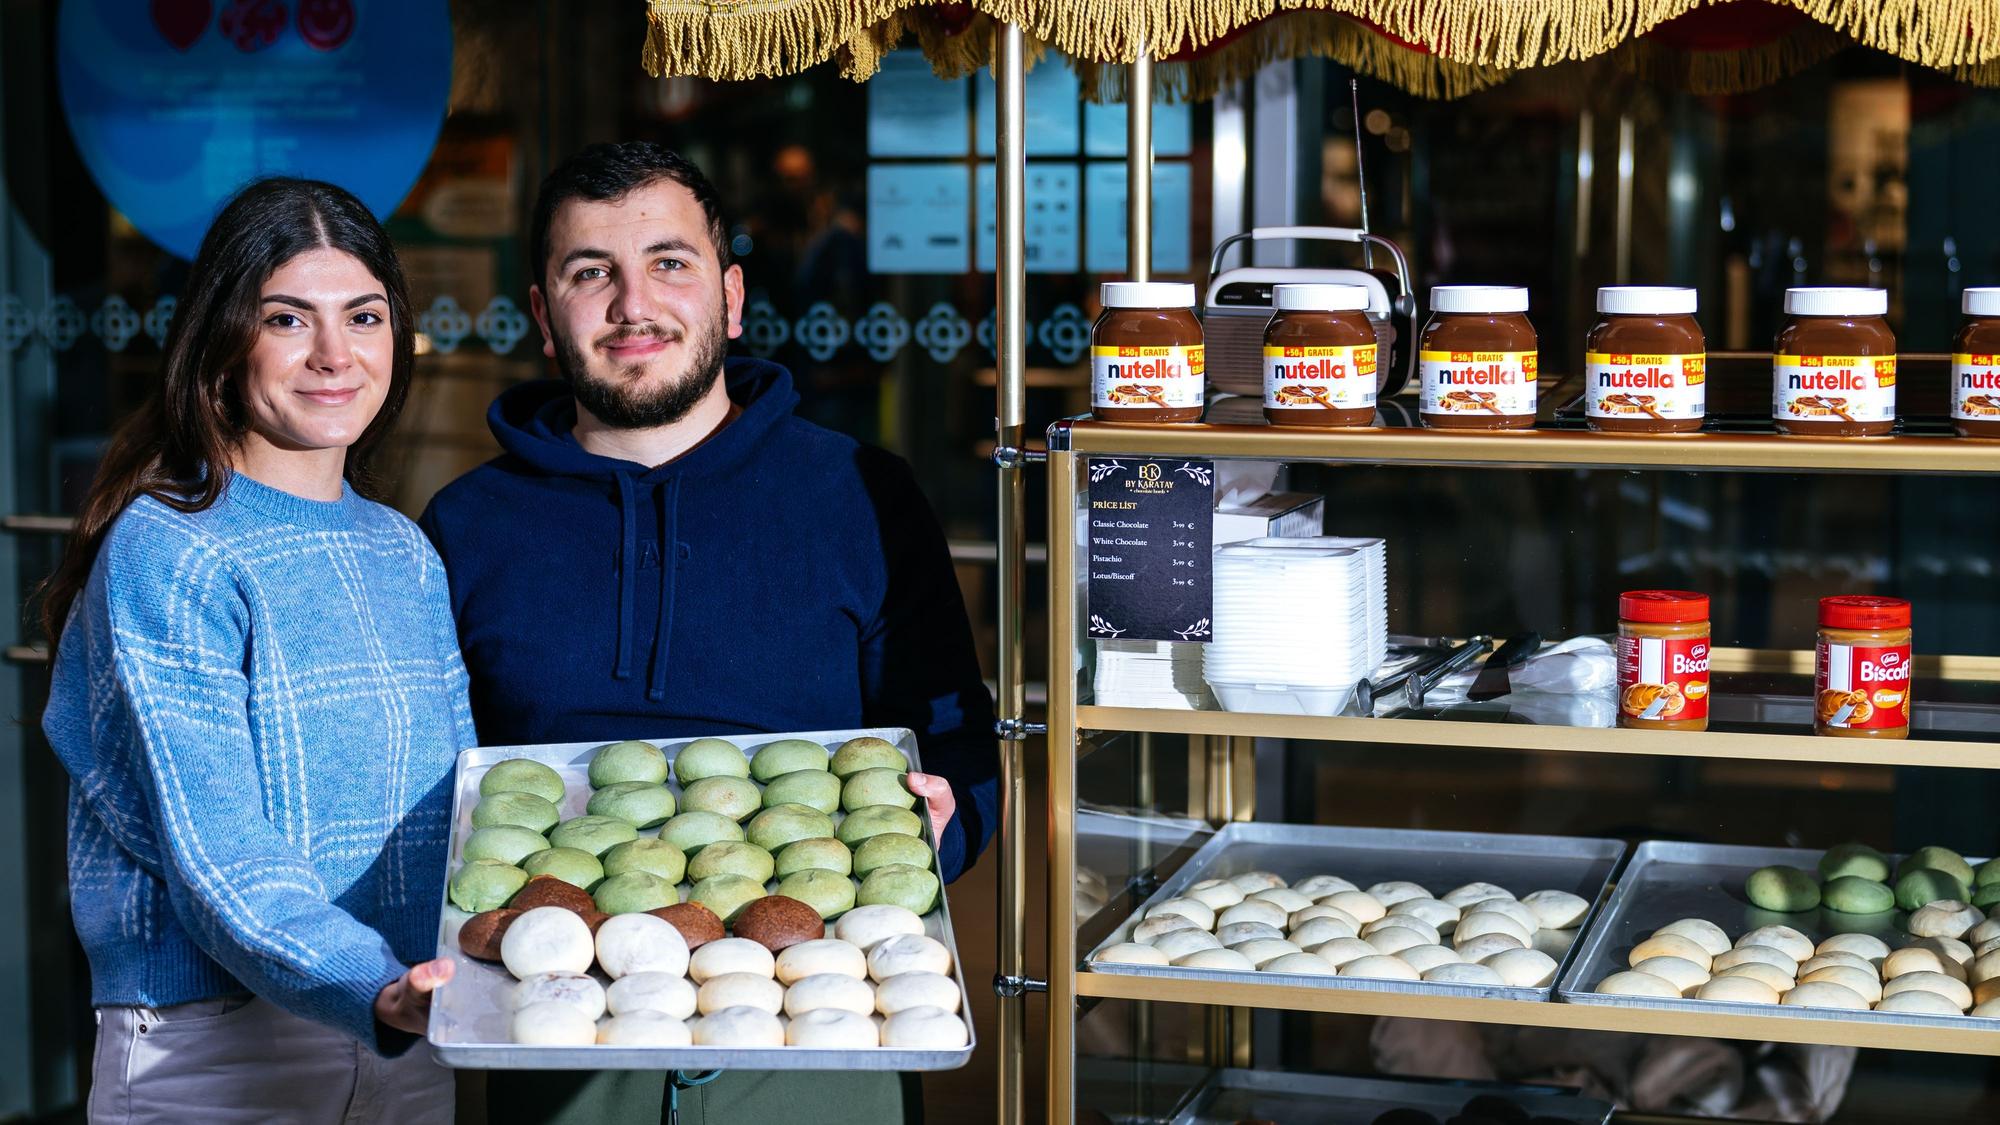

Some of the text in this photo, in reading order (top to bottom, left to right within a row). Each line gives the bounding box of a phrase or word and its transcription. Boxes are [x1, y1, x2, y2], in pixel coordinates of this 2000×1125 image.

[1477, 354, 1503, 362] GRATIS
[1108, 359, 1181, 378] nutella
[1275, 360, 1345, 379] nutella
[1440, 365, 1515, 384] nutella
[1600, 368, 1674, 388] nutella
[1789, 370, 1866, 390] nutella
[1962, 370, 2000, 388] nute
[1138, 480, 1174, 489] KARATAY
[1093, 520, 1115, 528] Classic
[1115, 538, 1147, 546] Chocolate
[1093, 572, 1135, 580] Lotus/Biscoff
[1861, 659, 1909, 681] Biscoff
